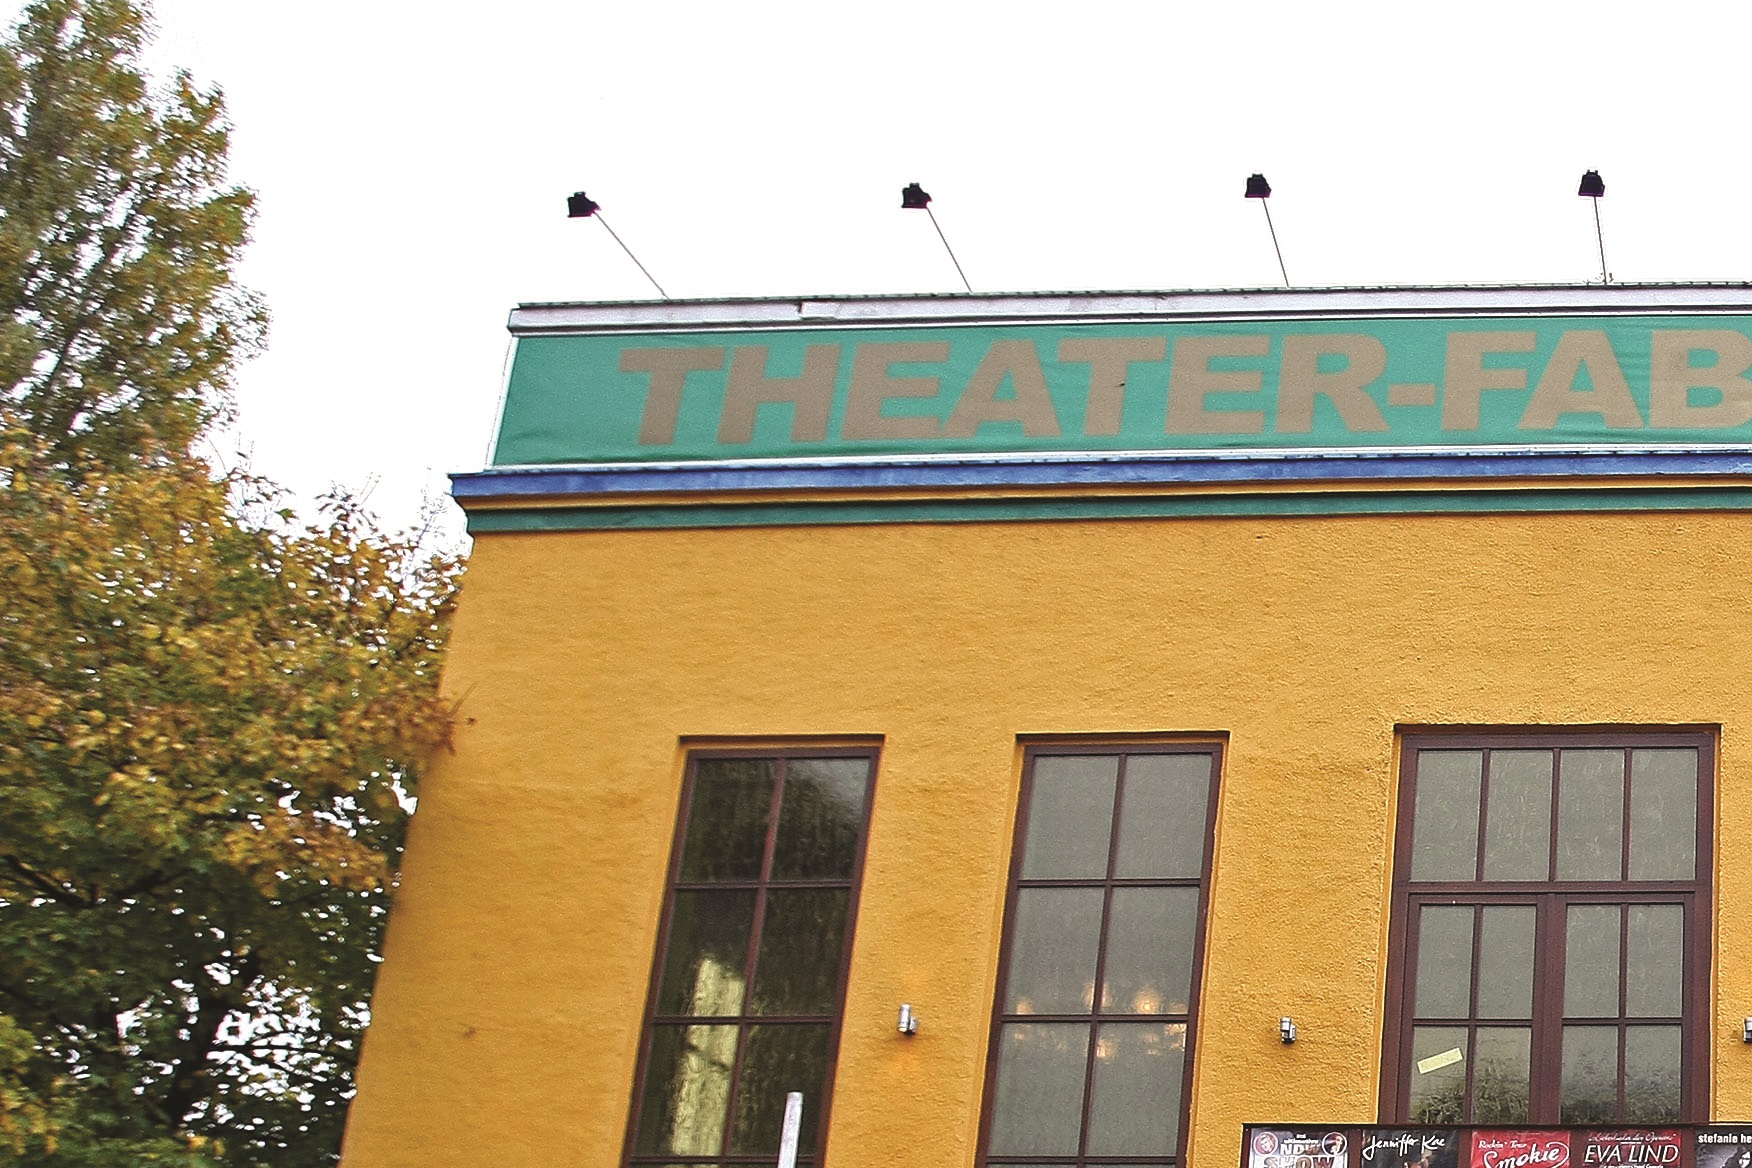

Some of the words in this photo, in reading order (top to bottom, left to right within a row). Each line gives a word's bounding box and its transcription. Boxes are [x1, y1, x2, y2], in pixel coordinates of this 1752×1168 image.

[1698, 1133, 1738, 1144] stefanie
[1280, 1143, 1321, 1155] NDW
[1584, 1144, 1621, 1163] EVA
[1628, 1144, 1679, 1163] LIND
